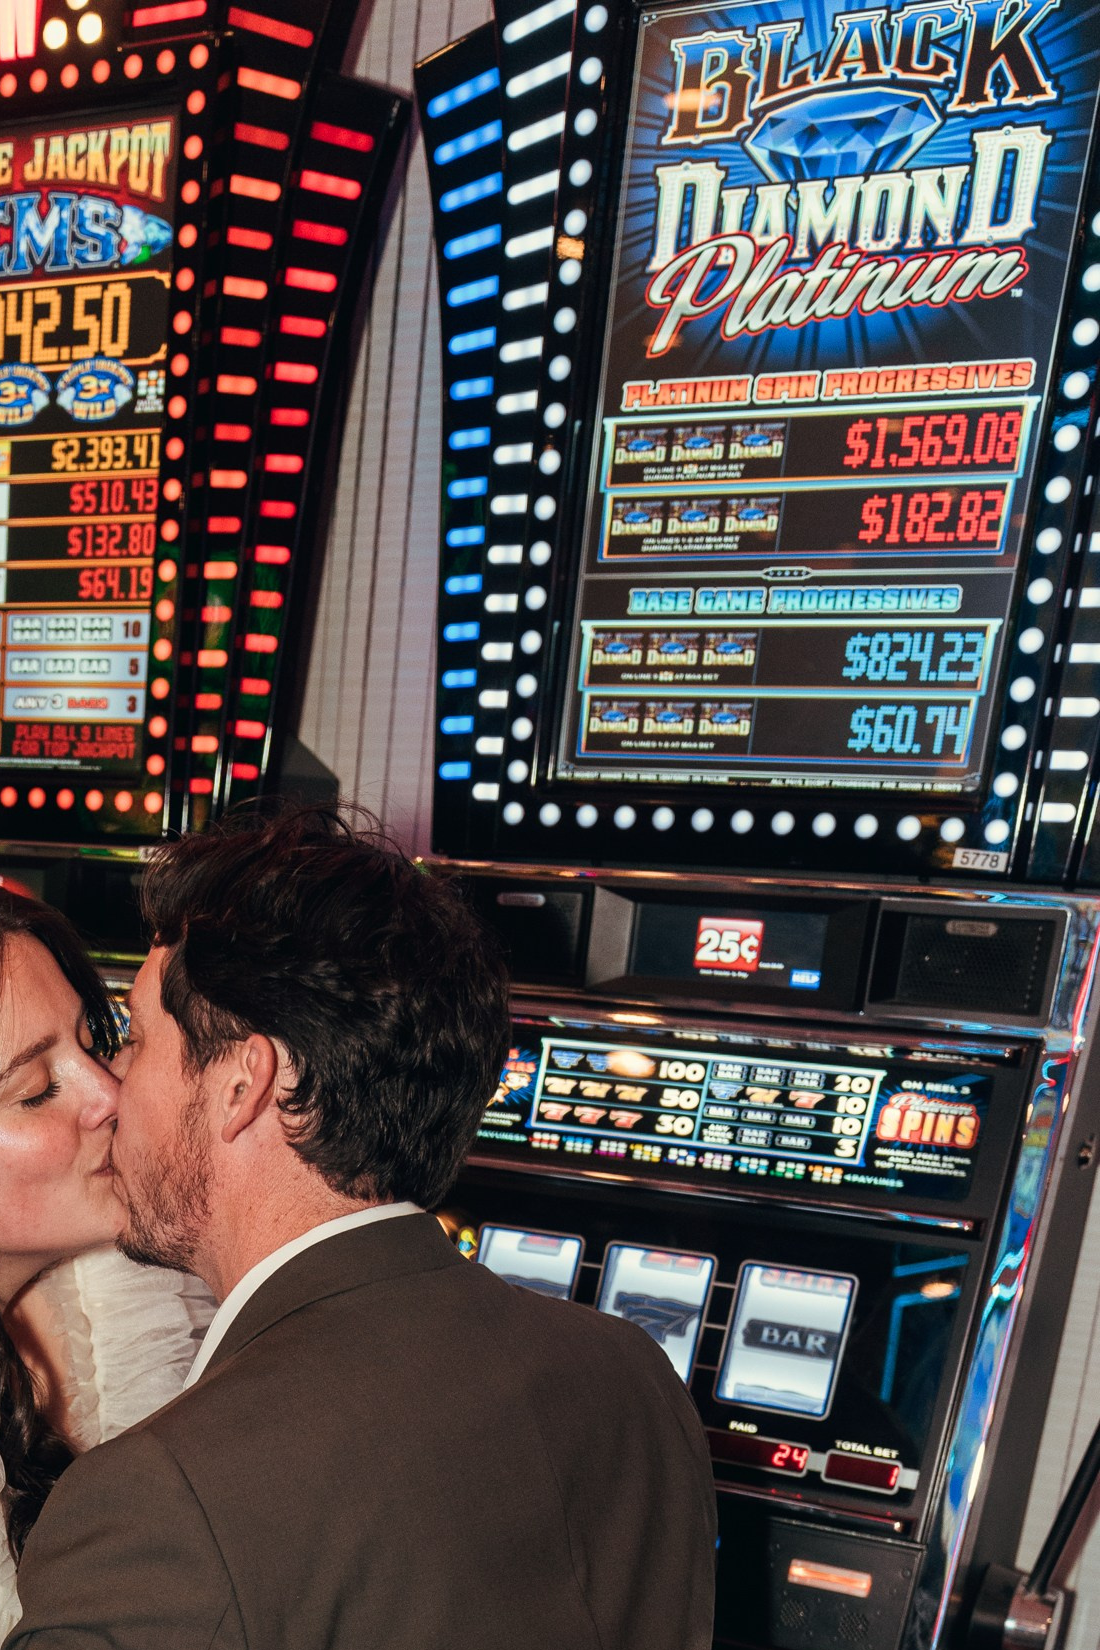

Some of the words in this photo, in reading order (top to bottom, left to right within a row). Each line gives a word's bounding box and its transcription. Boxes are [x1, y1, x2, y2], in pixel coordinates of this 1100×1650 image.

[663, 0, 1062, 146] BLACK
[23, 121, 171, 199] JACKPOT
[649, 125, 1053, 273] DIAMOND
[647, 232, 1029, 357] Platinum
[623, 376, 752, 409] PLATINUM
[755, 372, 821, 403] SPIN
[822, 359, 1036, 398] PROGRESSIVES
[51, 434, 160, 473] $2,393.41
[843, 411, 1023, 469] $1,569.08
[69, 478, 159, 513] $510.43
[858, 490, 1006, 543] $182.82
[67, 523, 156, 557] $132.80
[78, 567, 153, 600] $64.19
[627, 587, 695, 615] BASE
[695, 586, 767, 614] GAME
[768, 584, 963, 614] PROGRESSIVES
[123, 620, 141, 638] 10
[129, 658, 138, 676] 5
[842, 631, 987, 681] $824.23
[127, 696, 136, 713] 3
[847, 704, 970, 755] $60.74
[960, 851, 1000, 868] 5778
[695, 928, 759, 963] 25¢
[659, 1060, 706, 1082] 100
[718, 1062, 742, 1071] BAR
[757, 1066, 781, 1075] BAR
[795, 1070, 820, 1079] BAR
[834, 1074, 871, 1094] 20
[901, 1080, 923, 1090] ON
[925, 1082, 958, 1094] REEL
[960, 1086, 971, 1095] 3
[659, 1088, 700, 1110] 50
[836, 1096, 867, 1115] 10
[539, 1101, 573, 1121] 7
[574, 1105, 607, 1125] 7
[608, 1109, 644, 1129] 7
[655, 1114, 695, 1136] 30
[709, 1107, 733, 1117] BAR
[747, 1111, 771, 1121] BAR
[785, 1115, 809, 1126] BAR
[832, 1116, 862, 1136] 10
[742, 1128, 766, 1137] BAR
[879, 1106, 977, 1146] SPINS
[781, 1136, 805, 1147] BAR
[834, 1138, 858, 1157] 3
[760, 1326, 828, 1354] BAR
[729, 1419, 758, 1433] PAID
[771, 1444, 808, 1469] 24
[835, 1439, 872, 1455] TOTAL
[873, 1447, 899, 1459] BET
[889, 1466, 900, 1486] 1
